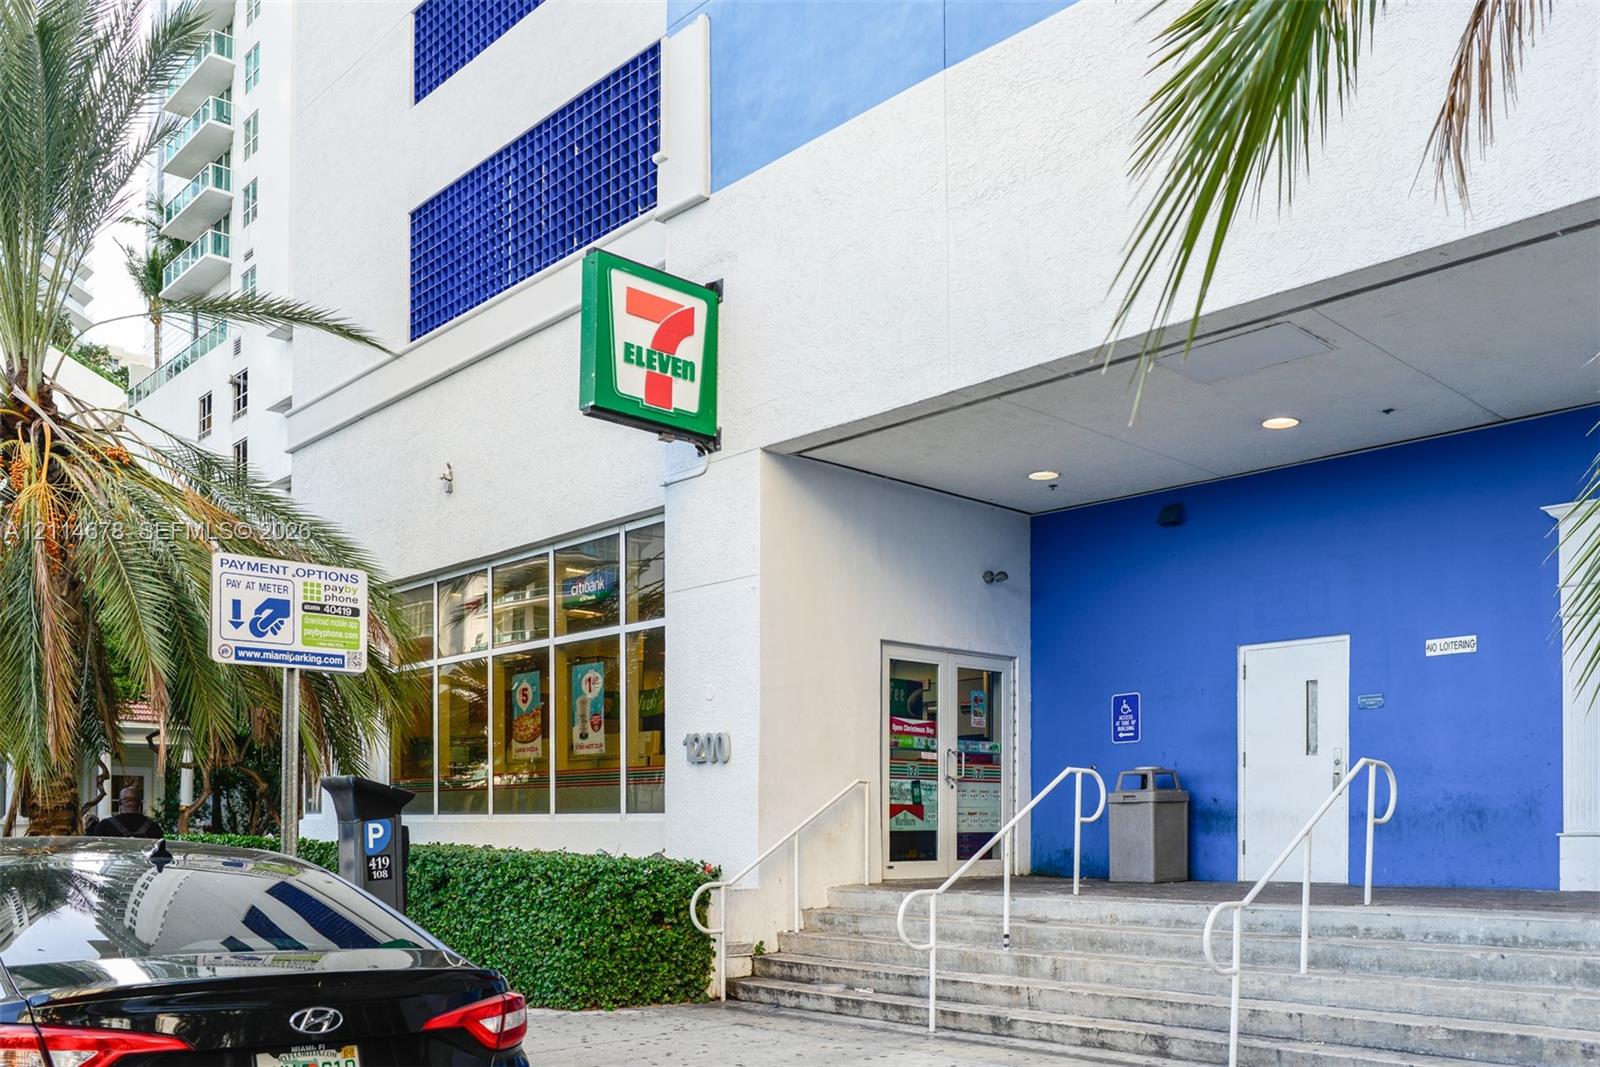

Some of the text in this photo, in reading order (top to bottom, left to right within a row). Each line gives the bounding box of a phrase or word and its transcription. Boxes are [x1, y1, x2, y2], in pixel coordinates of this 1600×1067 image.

[625, 286, 695, 410] 7
[220, 557, 360, 584] PAYMENT OPTIONS
[226, 579, 289, 594] PAY AT METER
[324, 593, 359, 604] phone
[323, 605, 352, 616] 40419
[1427, 638, 1476, 653] NO LOITERING
[237, 648, 343, 665] www.miamiparking.com
[892, 723, 935, 736] Open Christmas Day
[682, 732, 732, 765] 1200
[367, 822, 385, 849] P
[368, 855, 390, 870] 419
[372, 869, 389, 880] 108
